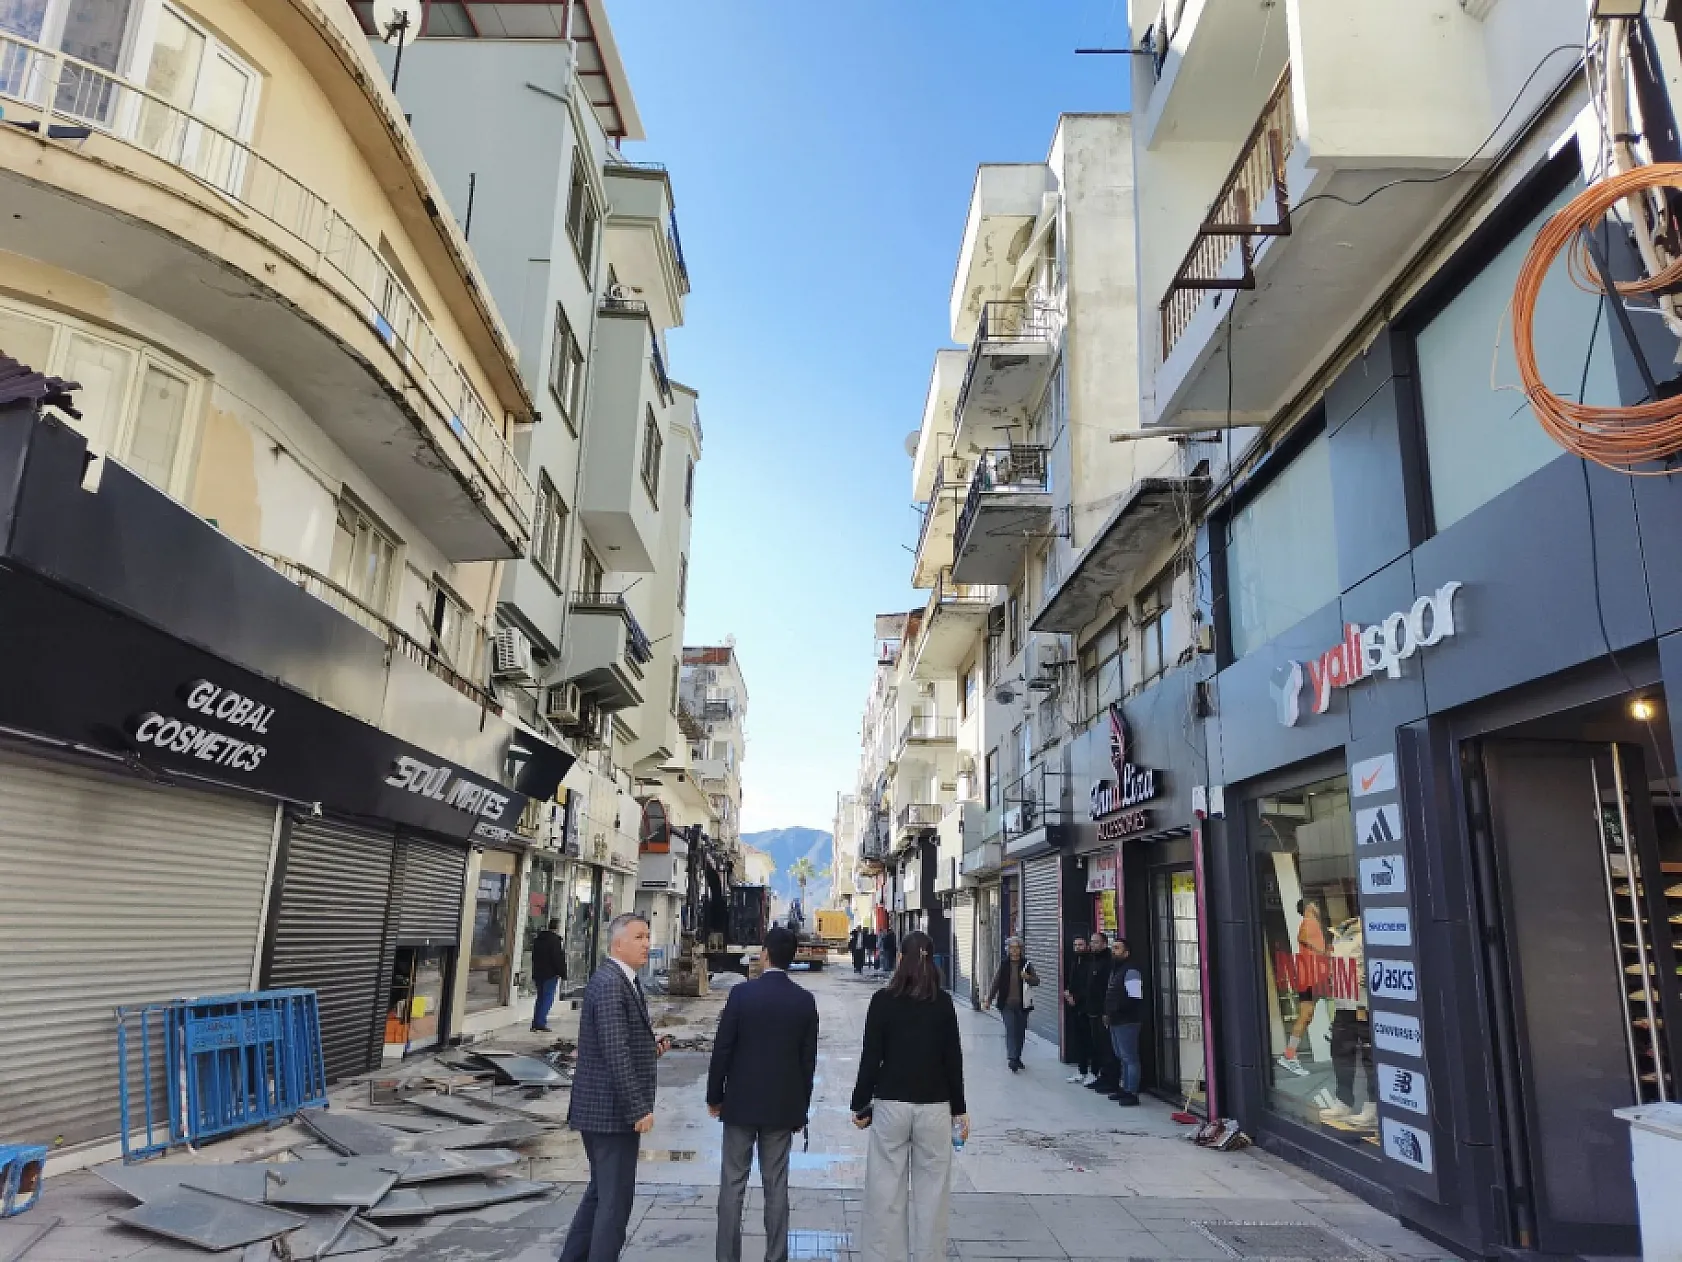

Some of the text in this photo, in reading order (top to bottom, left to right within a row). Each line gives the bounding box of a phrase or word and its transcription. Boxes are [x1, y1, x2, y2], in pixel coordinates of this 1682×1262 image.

[187, 680, 276, 735] GLOBAL
[135, 713, 268, 772] COSMETICS
[384, 755, 511, 821] SOUL MATES
